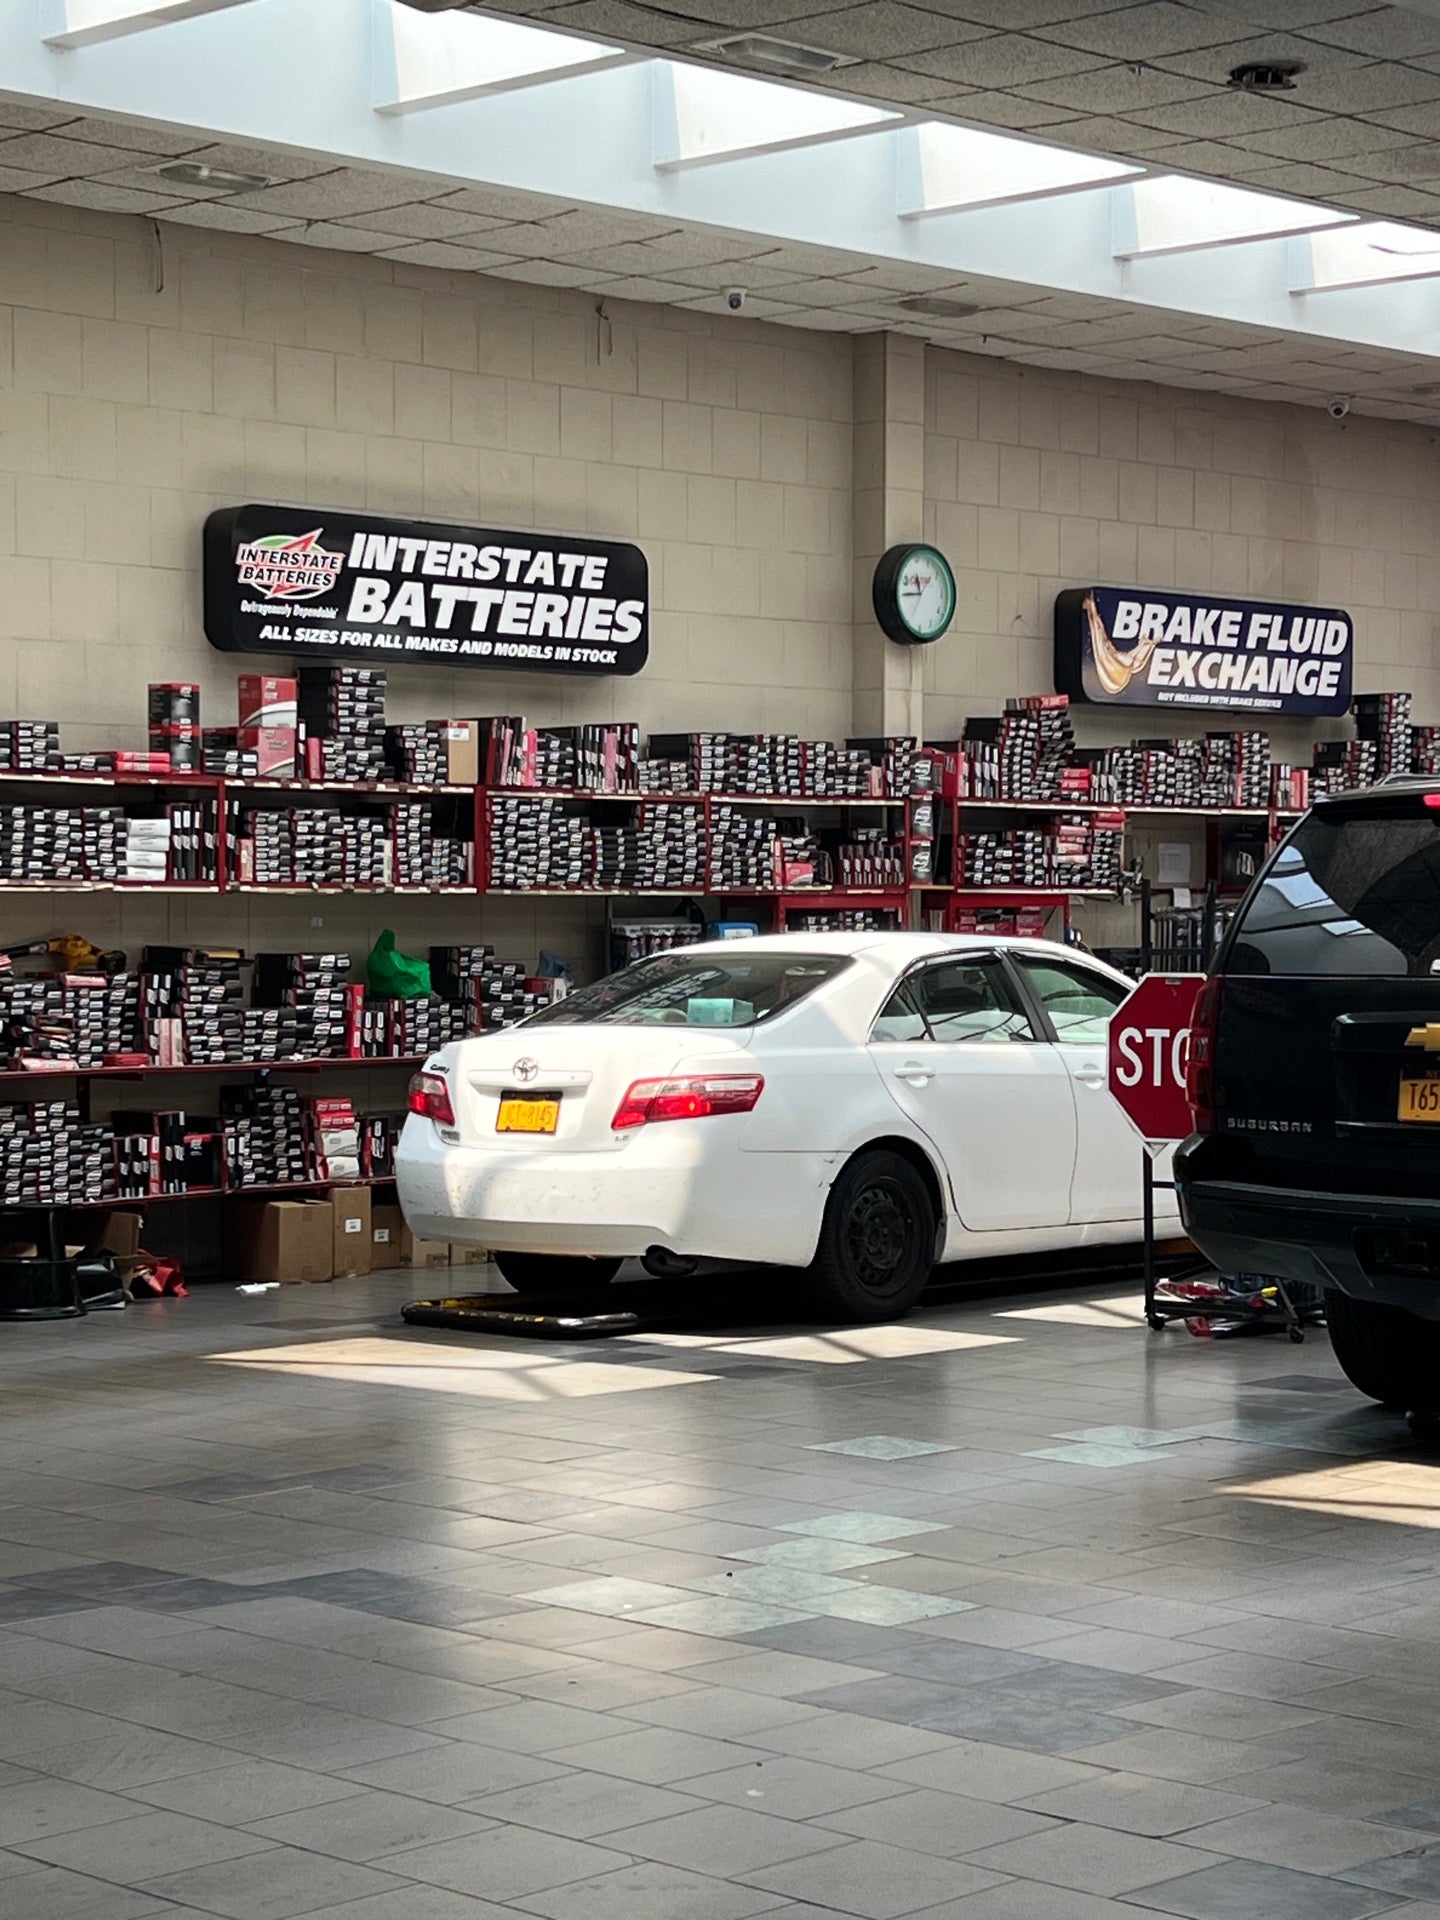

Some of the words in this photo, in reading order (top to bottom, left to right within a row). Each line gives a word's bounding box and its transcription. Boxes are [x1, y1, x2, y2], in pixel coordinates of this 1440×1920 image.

[240, 548, 340, 570] INTERSTATE
[243, 566, 333, 587] BATTERIES
[347, 532, 608, 590] INTERSTATE
[346, 577, 645, 643] BATTERIES
[1112, 601, 1243, 647] BRAKE
[1246, 613, 1348, 656] FLUID
[259, 625, 292, 641] ALL
[293, 627, 339, 645] SIZES
[340, 632, 374, 647] FOR
[373, 633, 402, 649] ALL
[404, 636, 459, 653] MAKES
[459, 640, 492, 655] AND
[493, 642, 554, 660] MODELS
[554, 647, 571, 661] IN
[571, 649, 618, 664] STOCK
[1147, 648, 1342, 697] EXCHANGE
[1116, 1027, 1191, 1088] STO
[1409, 1082, 1440, 1111] T65
[1226, 1117, 1313, 1133] SUBURBAN
